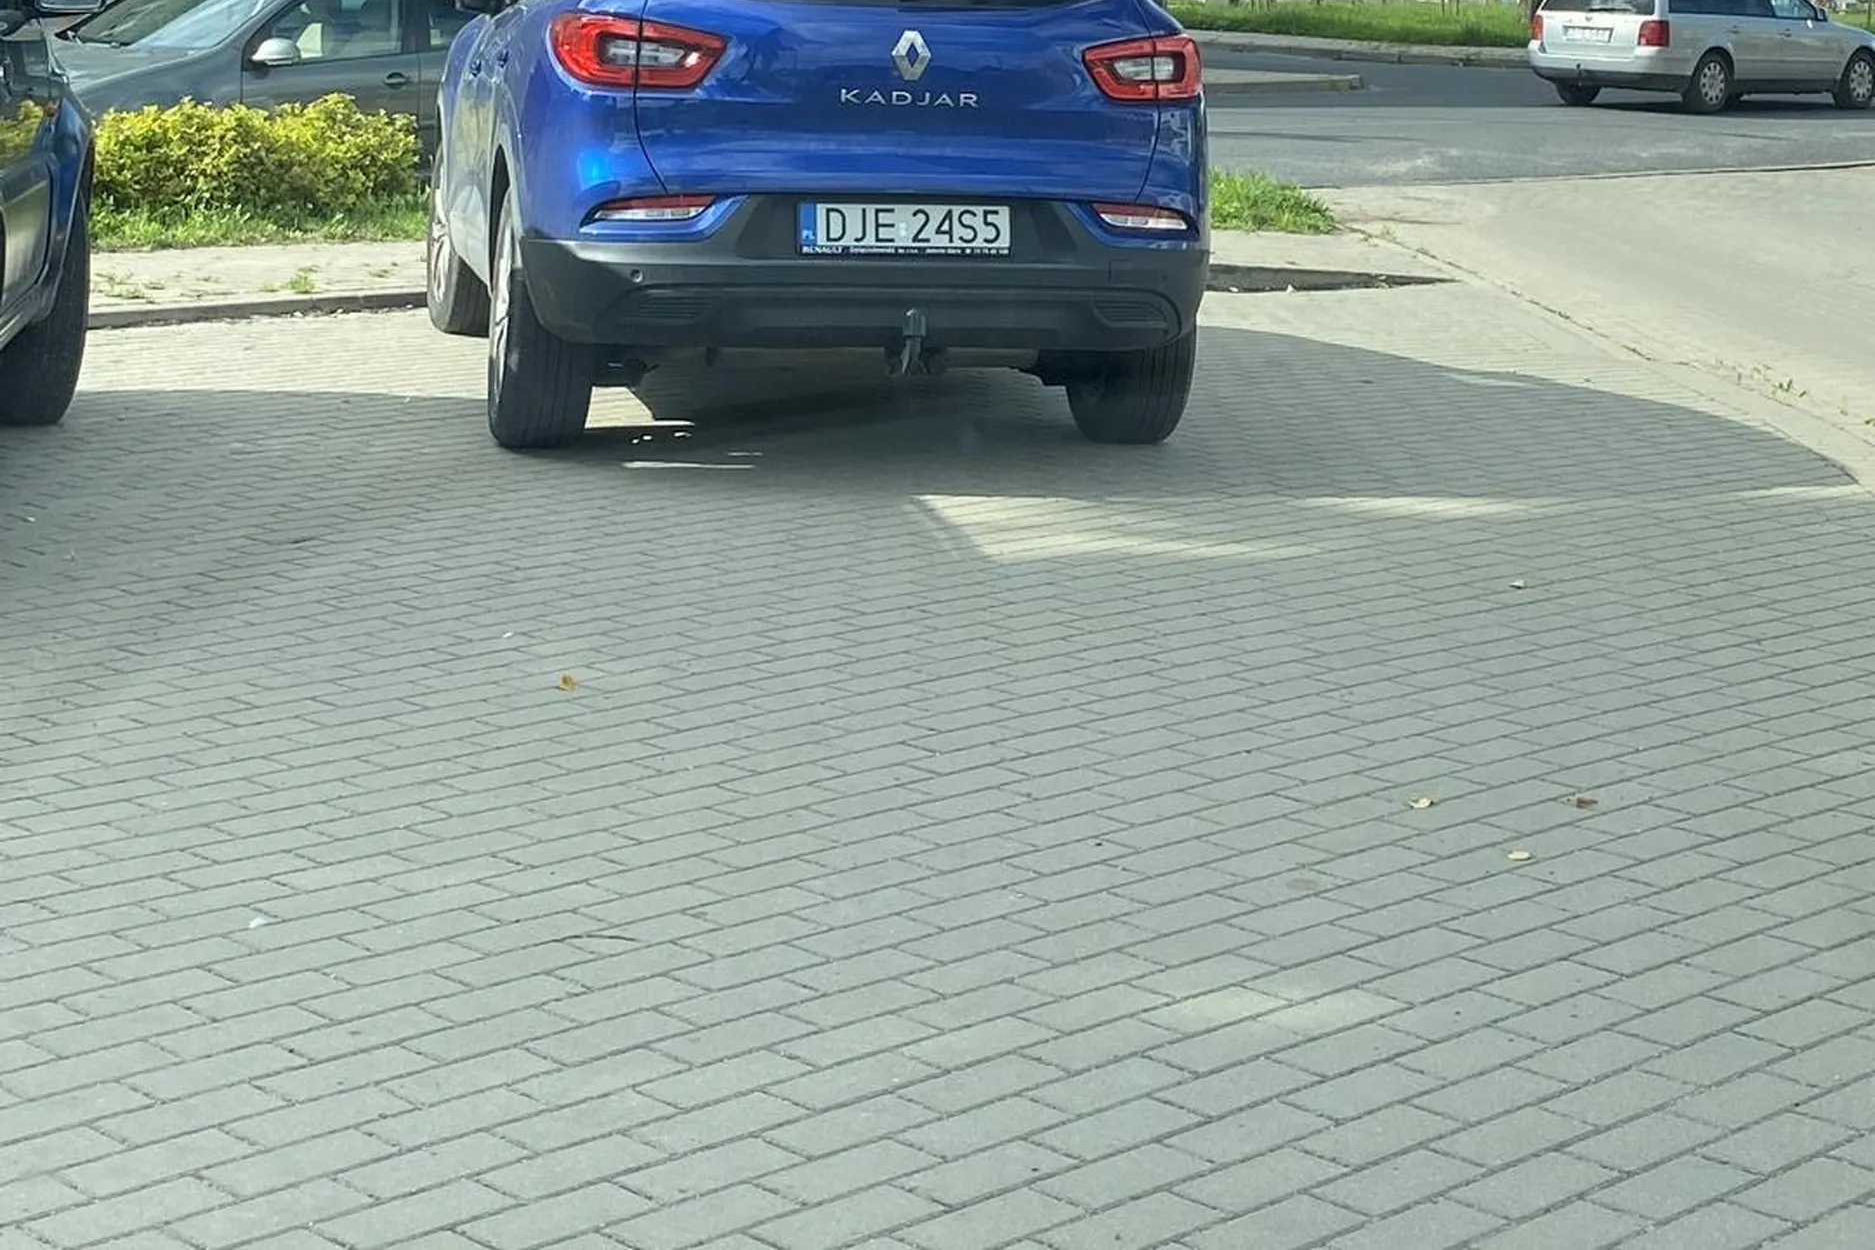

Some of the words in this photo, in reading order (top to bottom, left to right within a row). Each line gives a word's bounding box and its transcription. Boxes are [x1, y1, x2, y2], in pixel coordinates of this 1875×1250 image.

[840, 88, 979, 108] KADJAR
[825, 207, 896, 243] DJE
[911, 208, 1001, 244] 24S5
